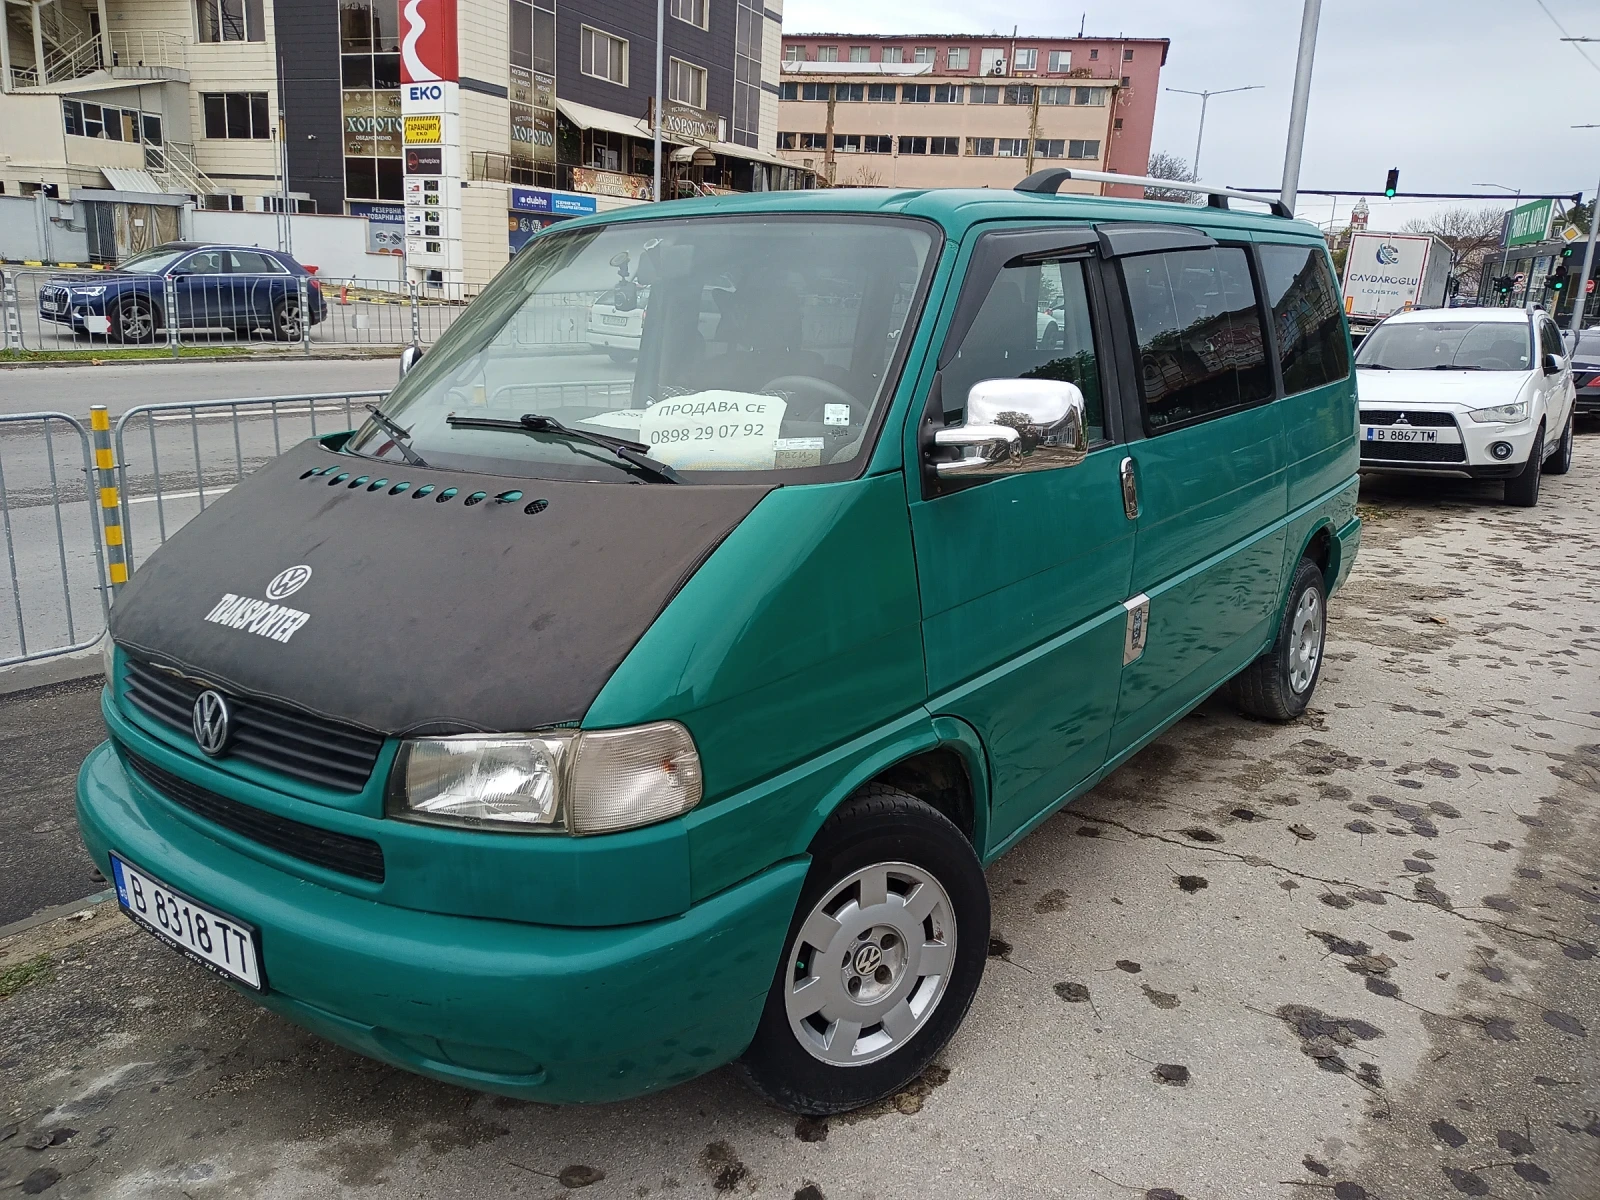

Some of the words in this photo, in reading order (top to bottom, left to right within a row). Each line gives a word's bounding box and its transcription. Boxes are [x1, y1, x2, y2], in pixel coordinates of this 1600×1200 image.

[511, 68, 530, 79] МУЗИКА
[410, 86, 442, 100] EKO
[408, 123, 437, 132] ГАРАНЦИЯ
[512, 124, 553, 146] ХОРОТО
[668, 116, 706, 137] ХОРОТО
[658, 401, 740, 417] ПРОДАВА
[745, 402, 766, 414] СЕ
[650, 427, 690, 445] 0898
[694, 426, 714, 441] 29
[718, 424, 738, 438] 07
[743, 423, 764, 437] 92
[204, 593, 310, 644] TRANSPORTER
